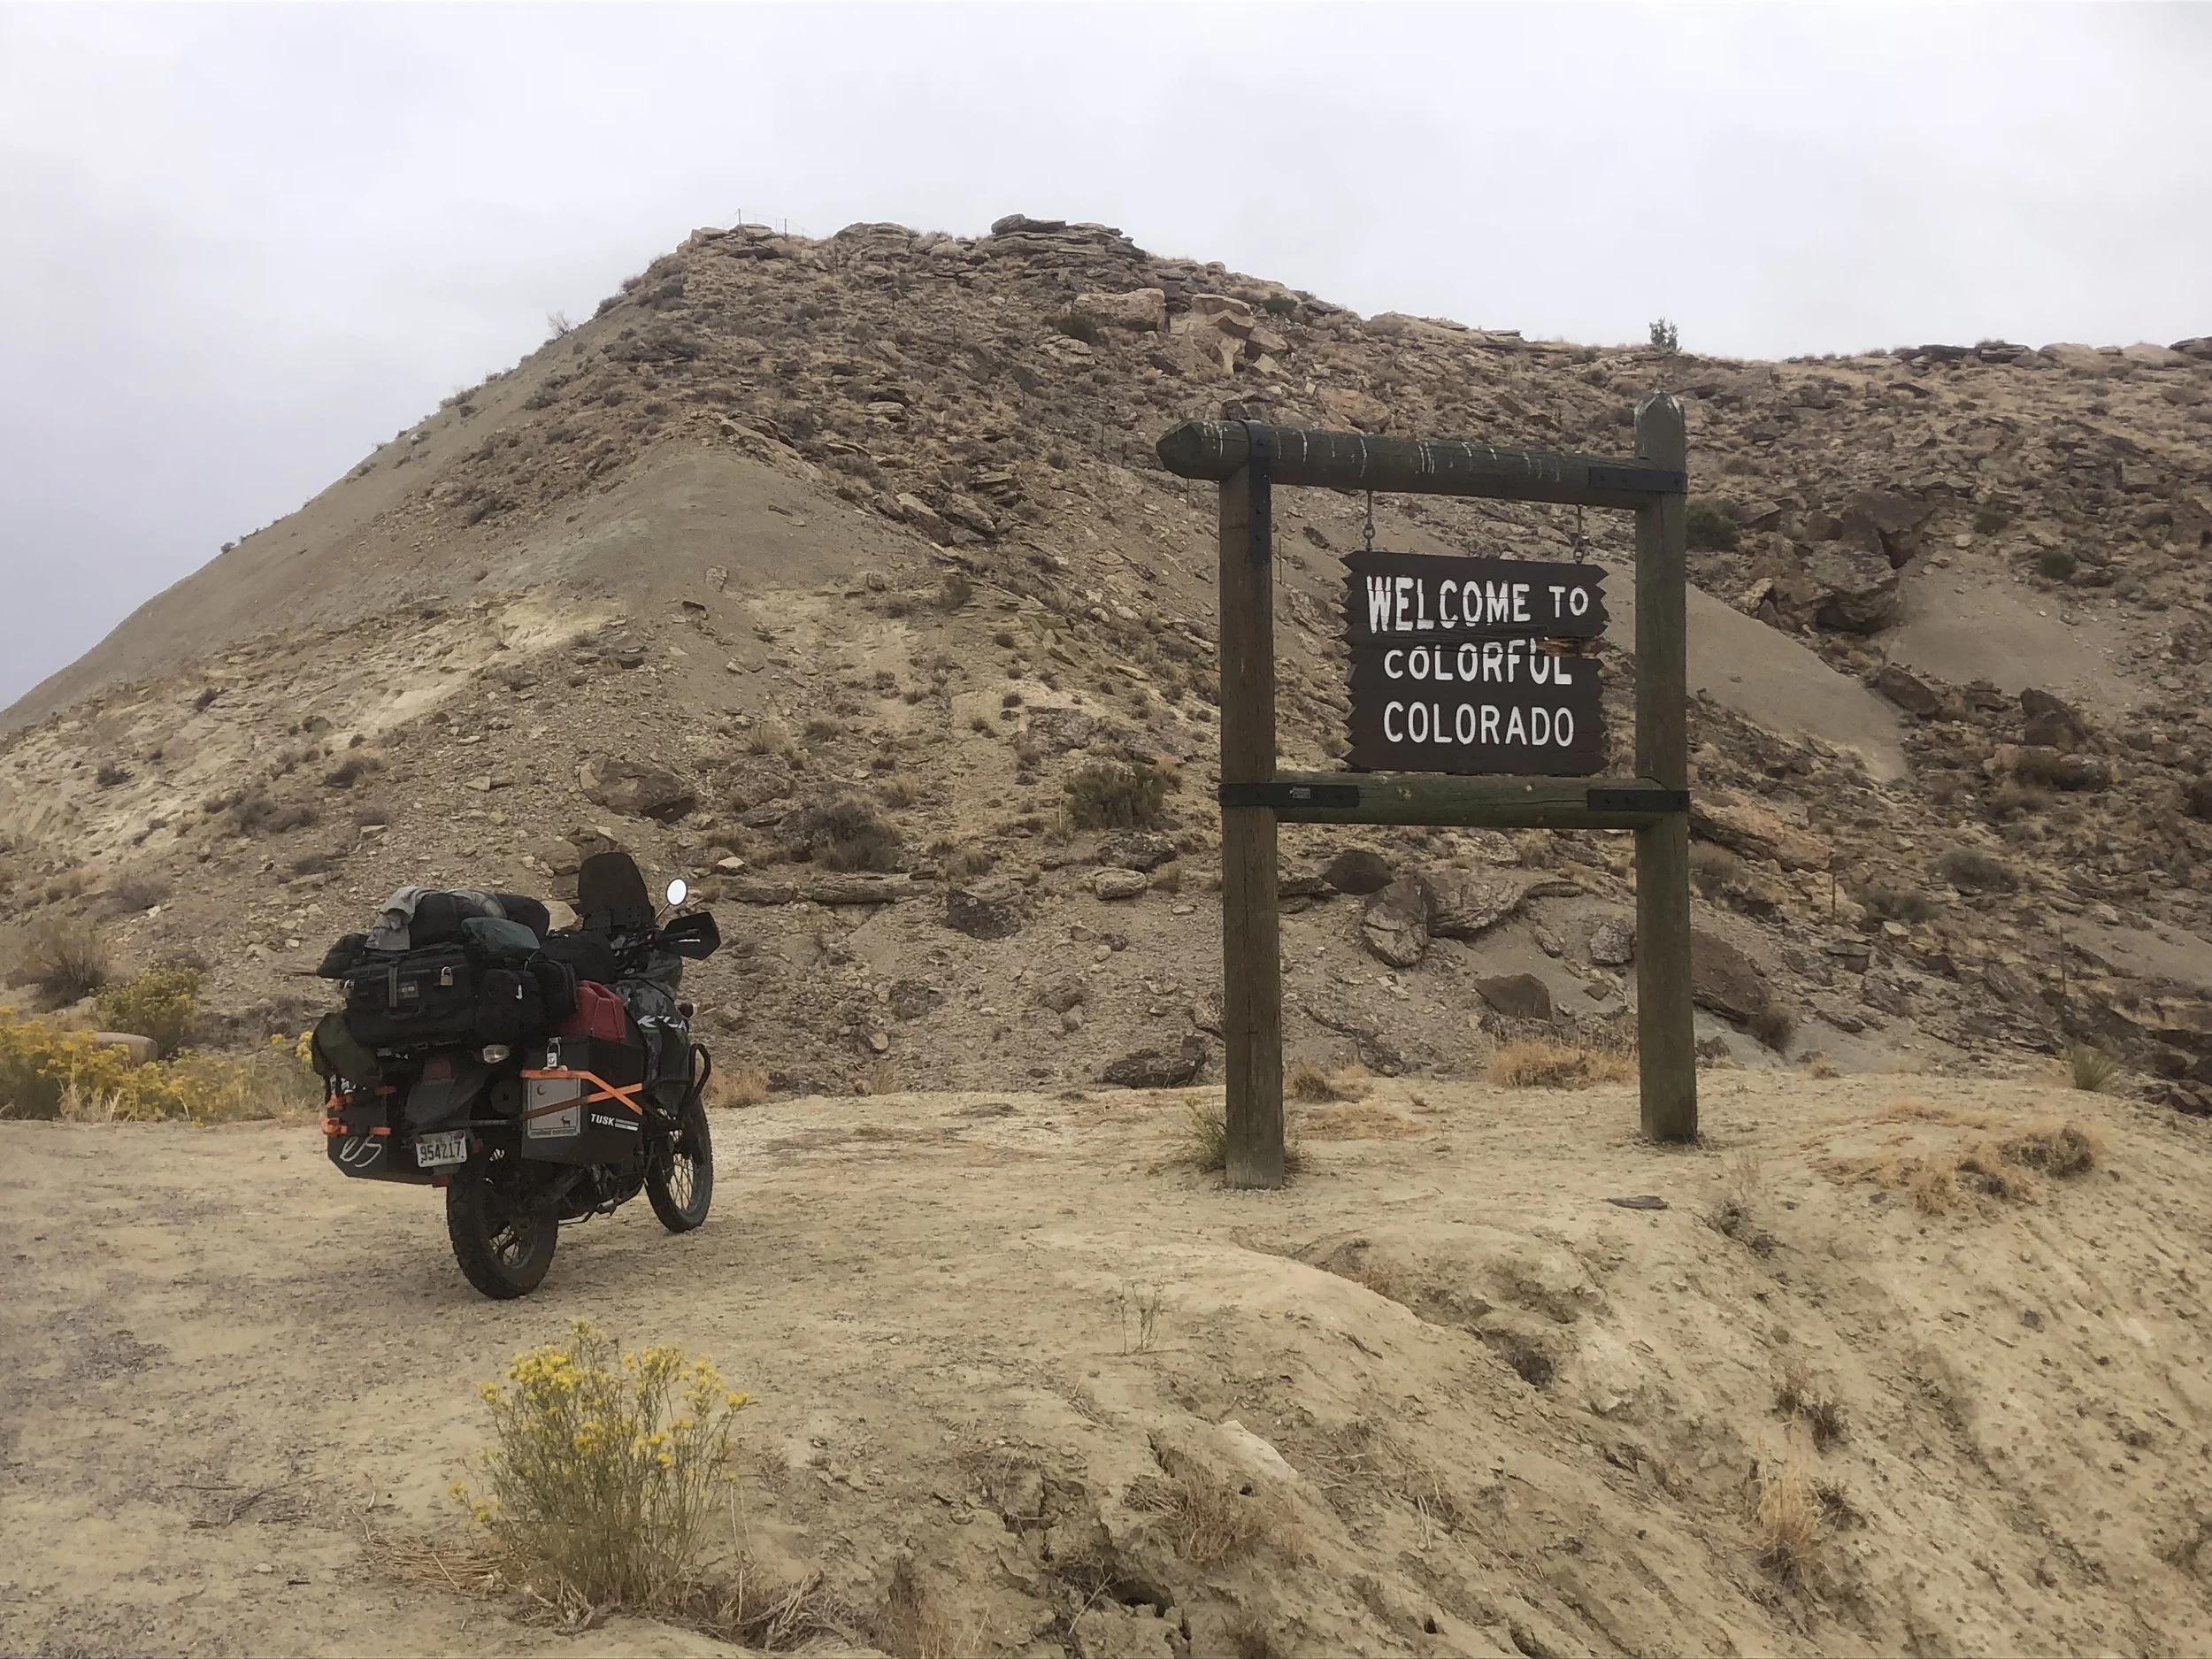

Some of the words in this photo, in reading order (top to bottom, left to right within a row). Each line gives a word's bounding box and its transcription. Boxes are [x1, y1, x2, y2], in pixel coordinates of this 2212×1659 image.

[1366, 574, 1531, 634] WELCOME
[1548, 585, 1589, 618] TO
[1384, 636, 1572, 685] COLORFUL
[1384, 701, 1574, 747] COLORADO
[591, 1113, 615, 1126] TUSK
